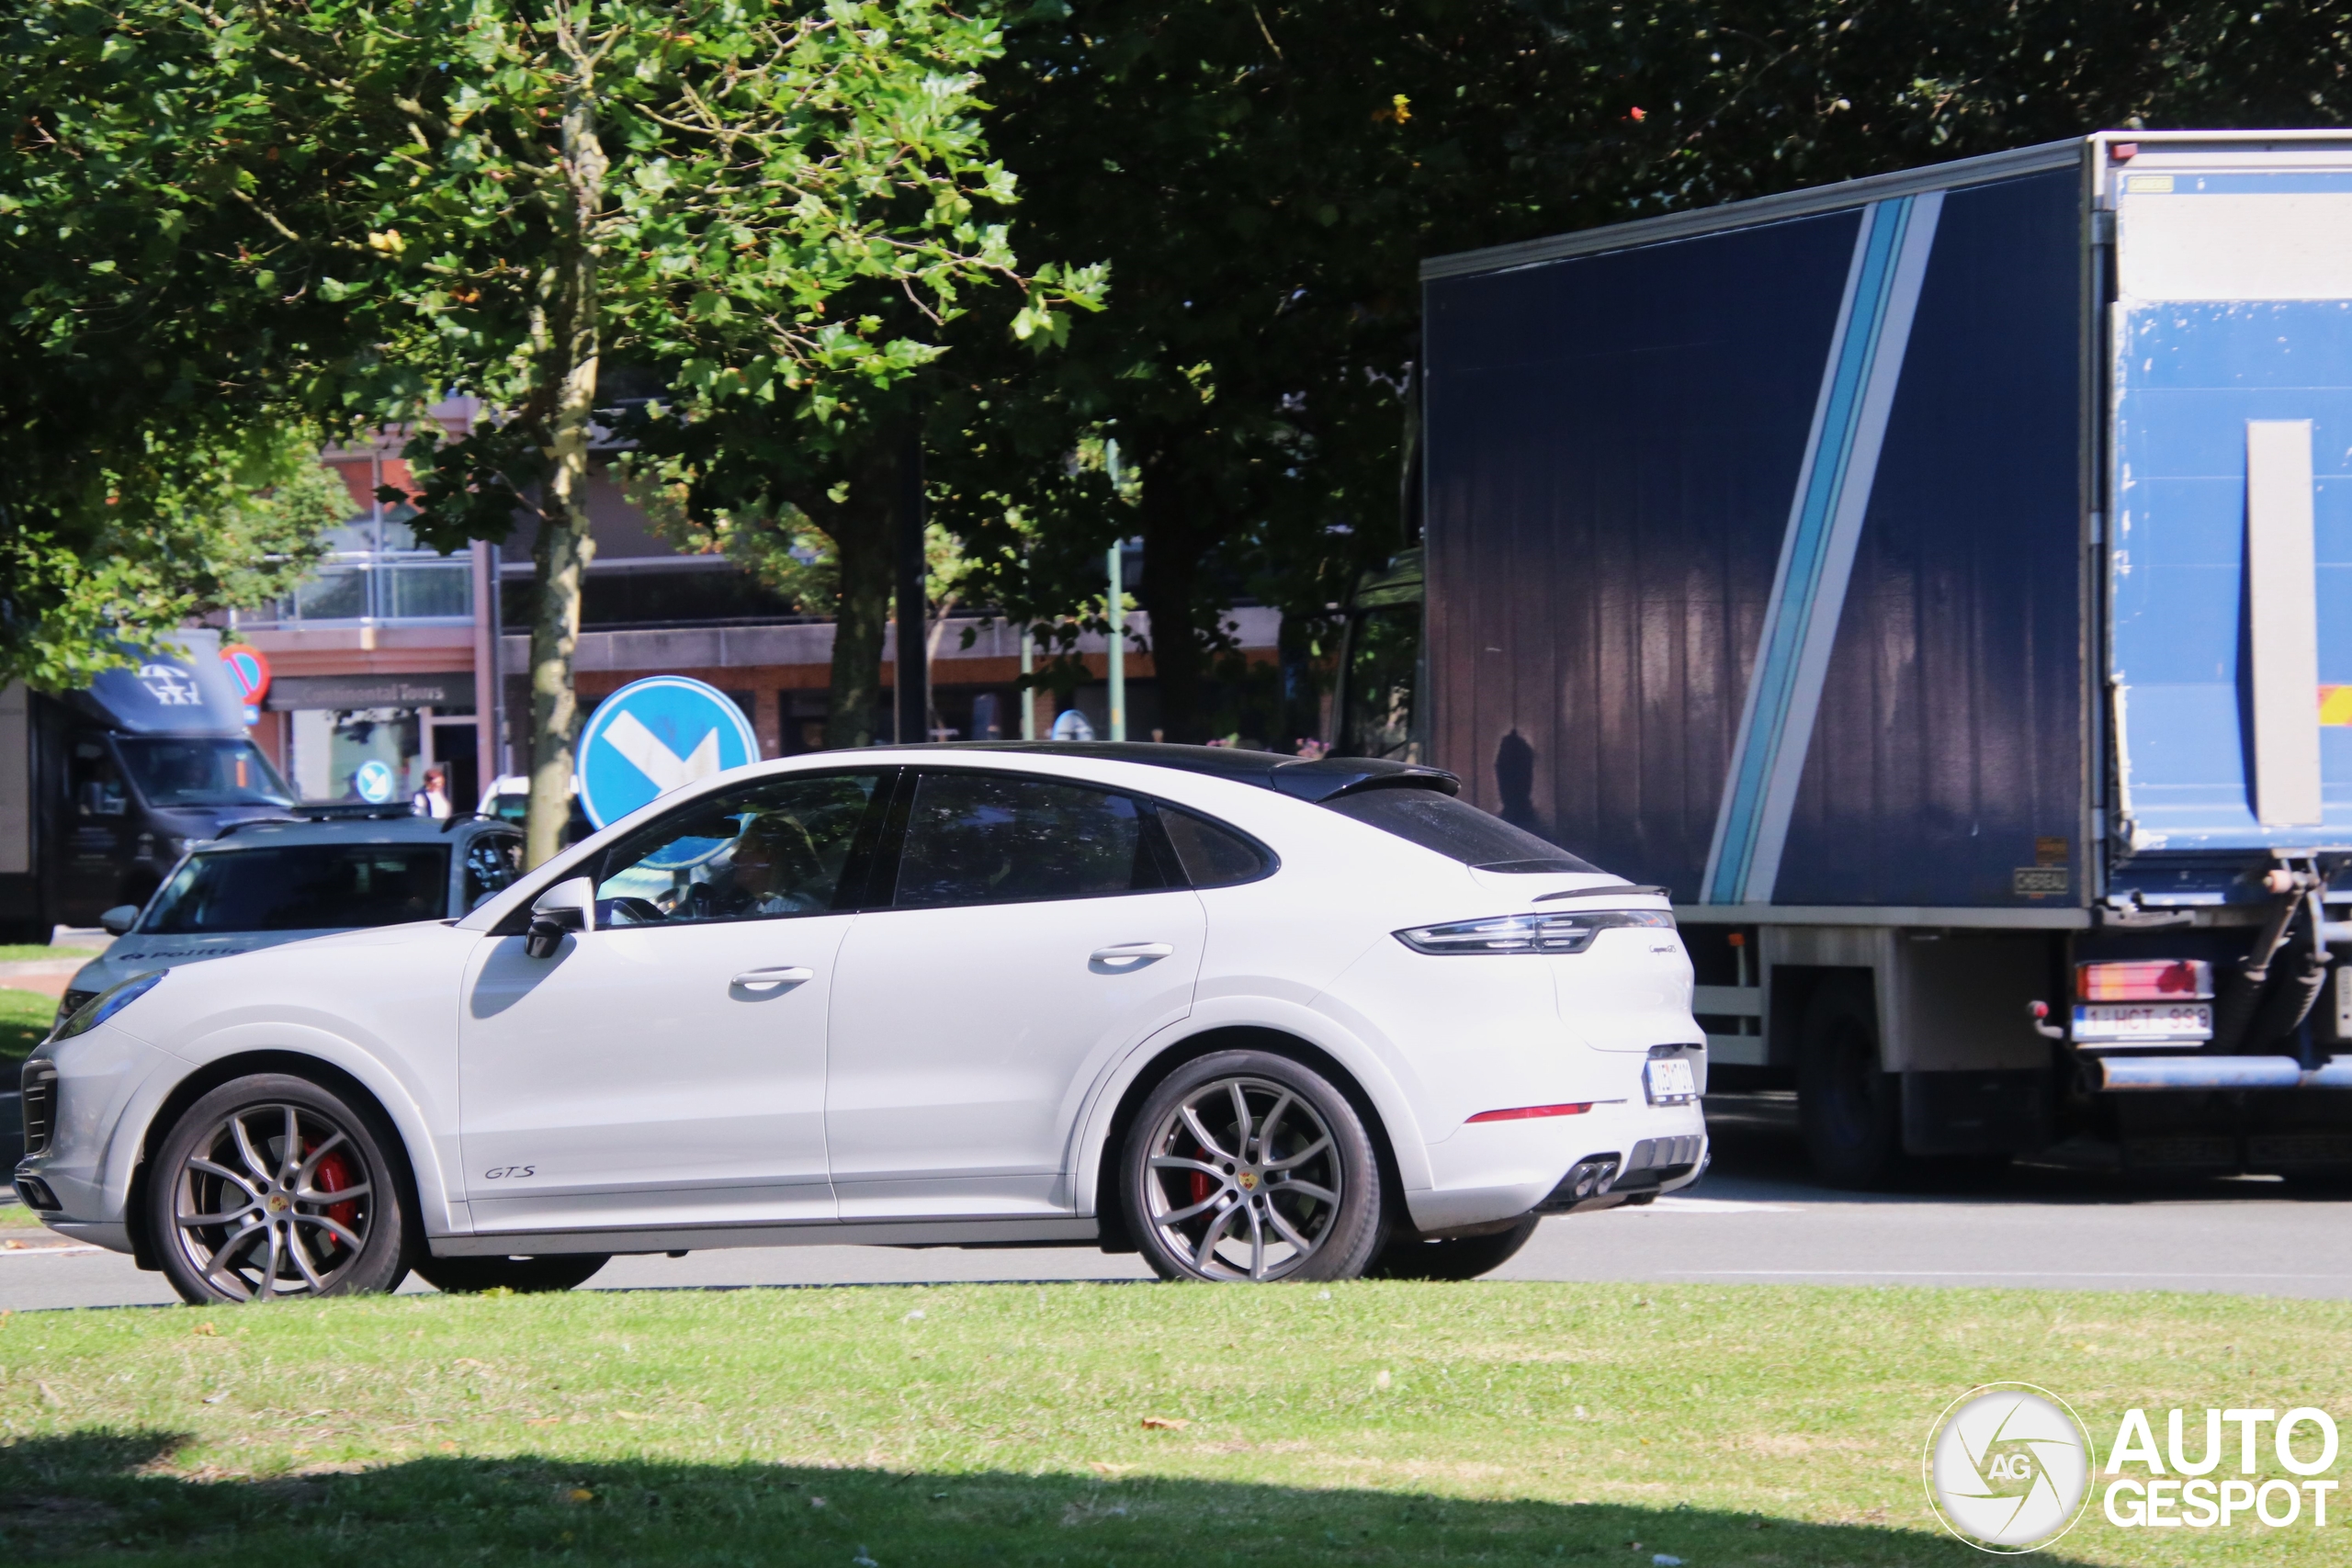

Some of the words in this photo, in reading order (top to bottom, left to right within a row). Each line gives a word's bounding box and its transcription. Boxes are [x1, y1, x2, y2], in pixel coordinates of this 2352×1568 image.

[303, 682, 398, 703] Continental
[399, 682, 446, 701] Tours
[484, 1165, 536, 1179] GTS
